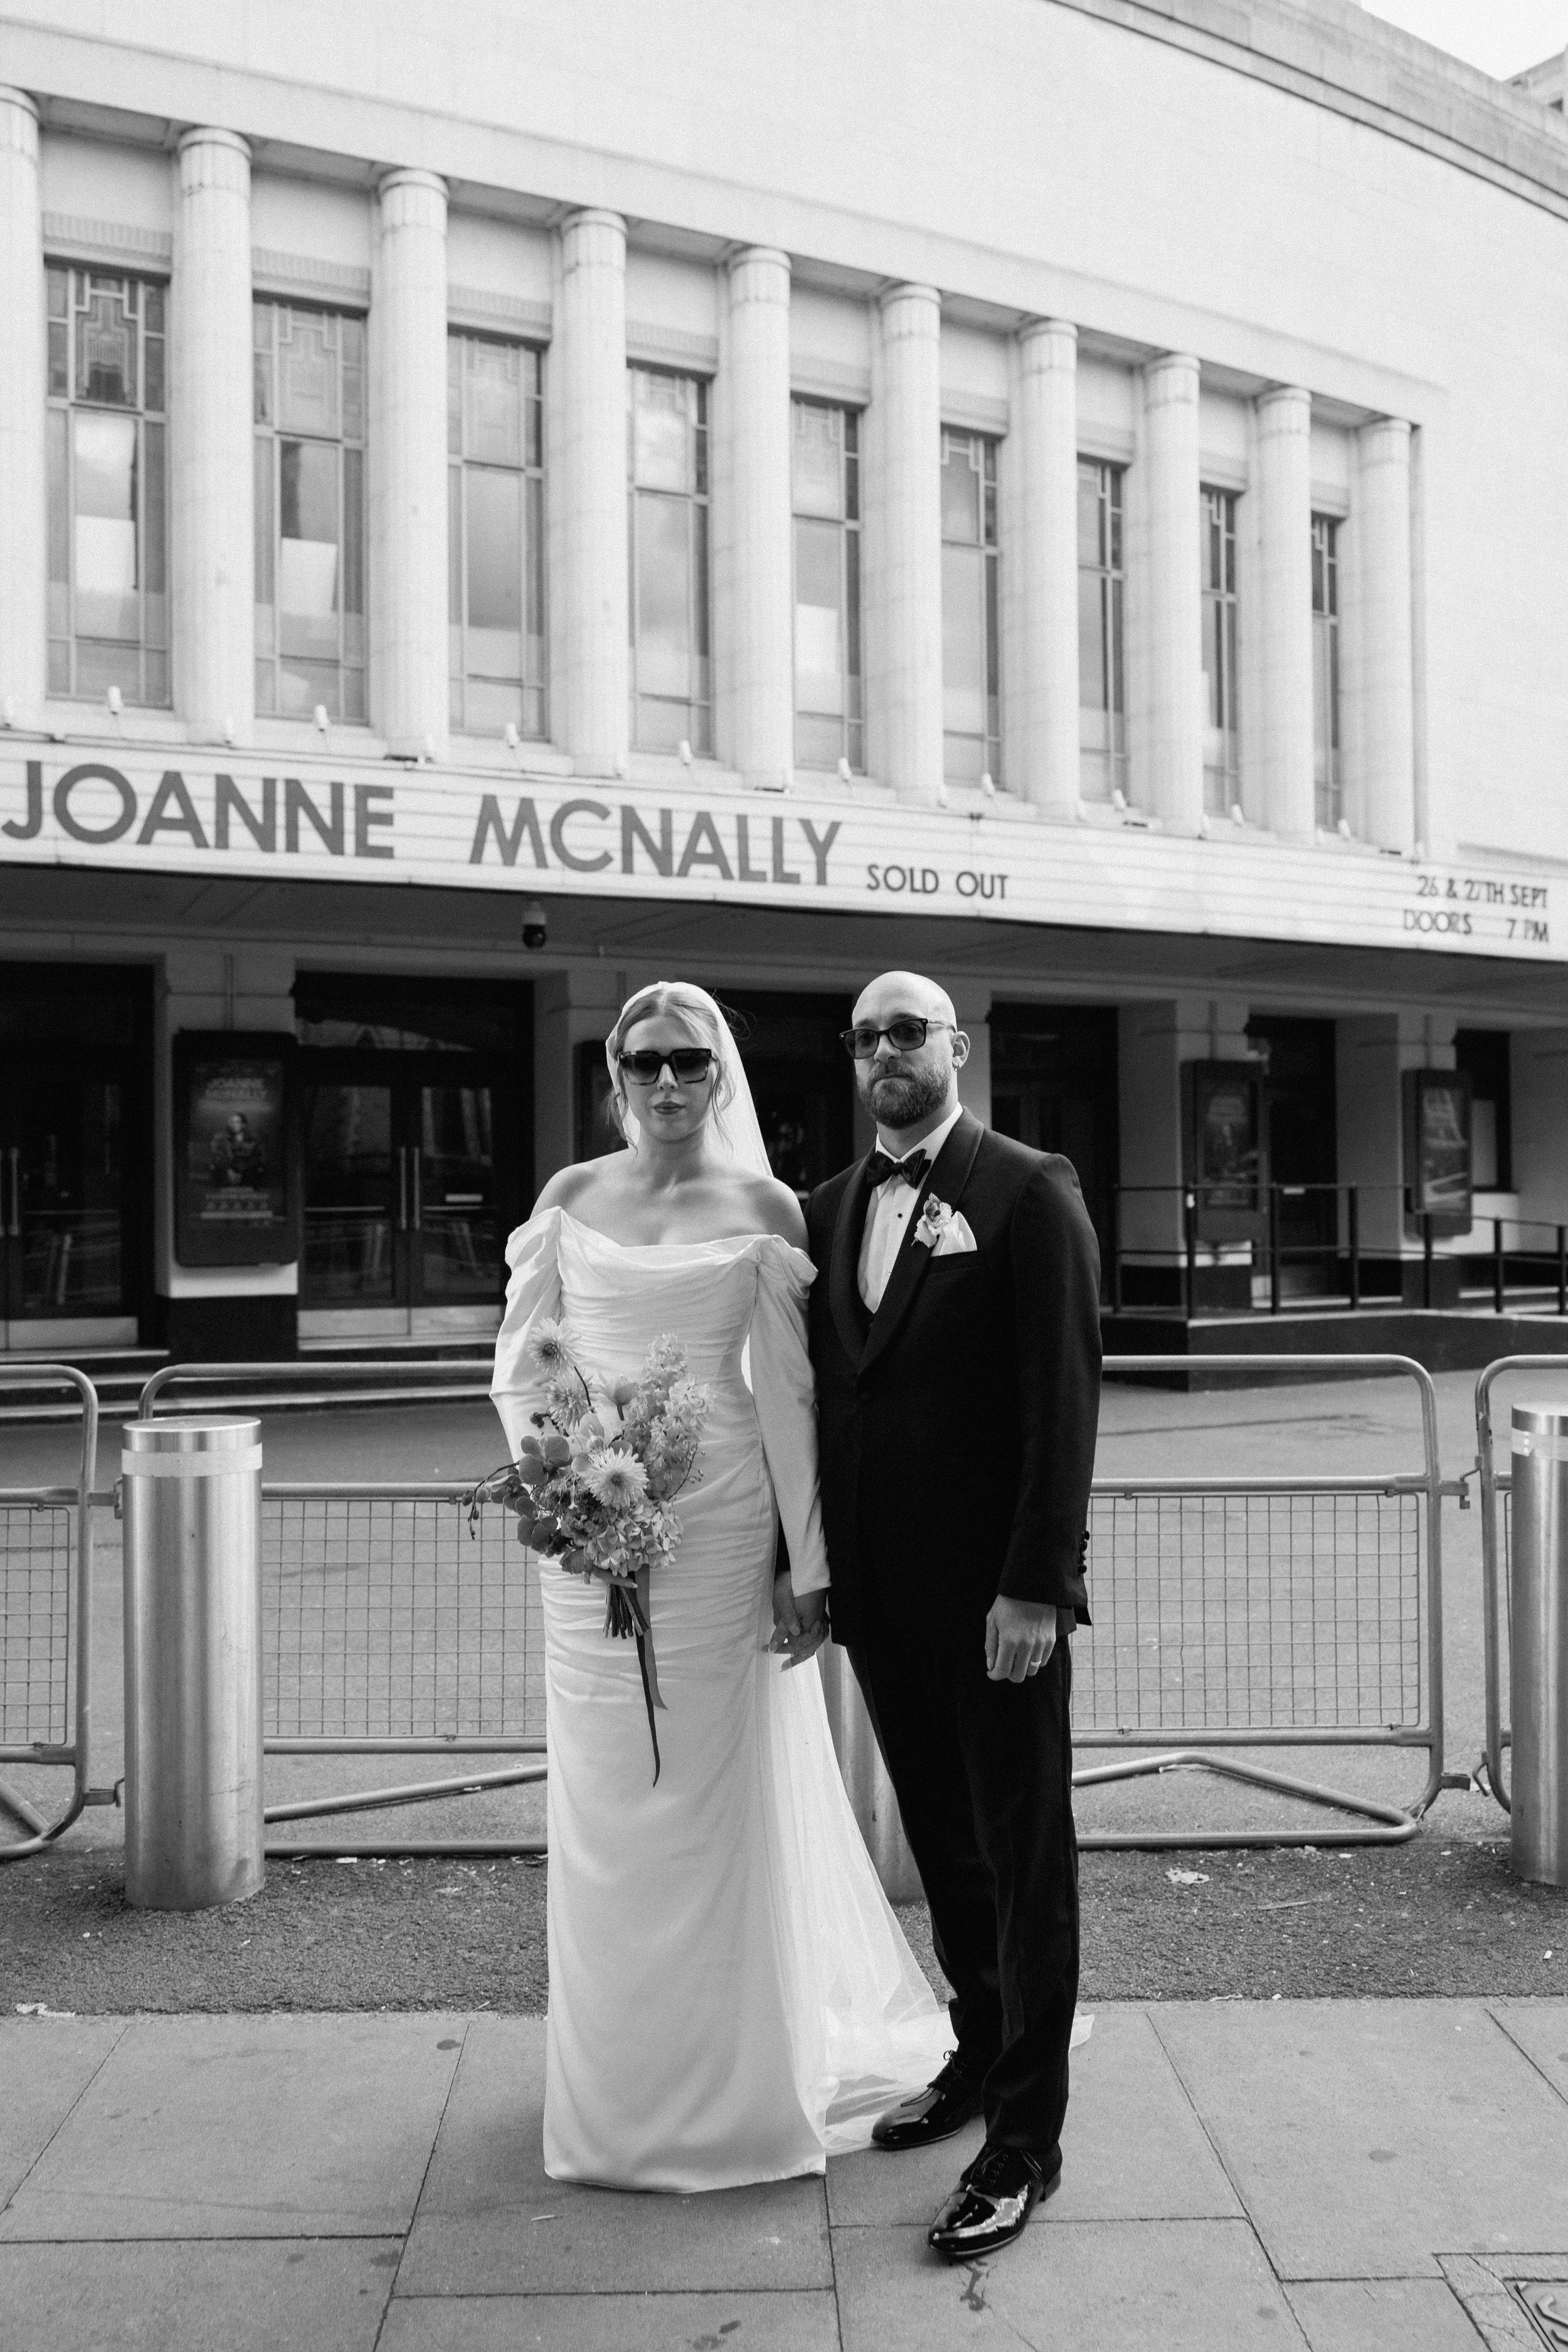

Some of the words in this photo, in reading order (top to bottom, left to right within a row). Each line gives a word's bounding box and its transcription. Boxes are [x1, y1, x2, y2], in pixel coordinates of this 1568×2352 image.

[1, 760, 394, 859] JOANNE
[468, 794, 842, 887] MCNALLY
[867, 864, 940, 894] SOLD
[955, 871, 1009, 899] OUT
[1417, 875, 1438, 897] 26
[1446, 878, 1457, 899] &
[1465, 879, 1504, 904] 27TH
[1510, 884, 1548, 908] SEPT
[1404, 909, 1473, 935] DOORS
[1507, 918, 1517, 939] 7
[1523, 918, 1550, 943] PM
